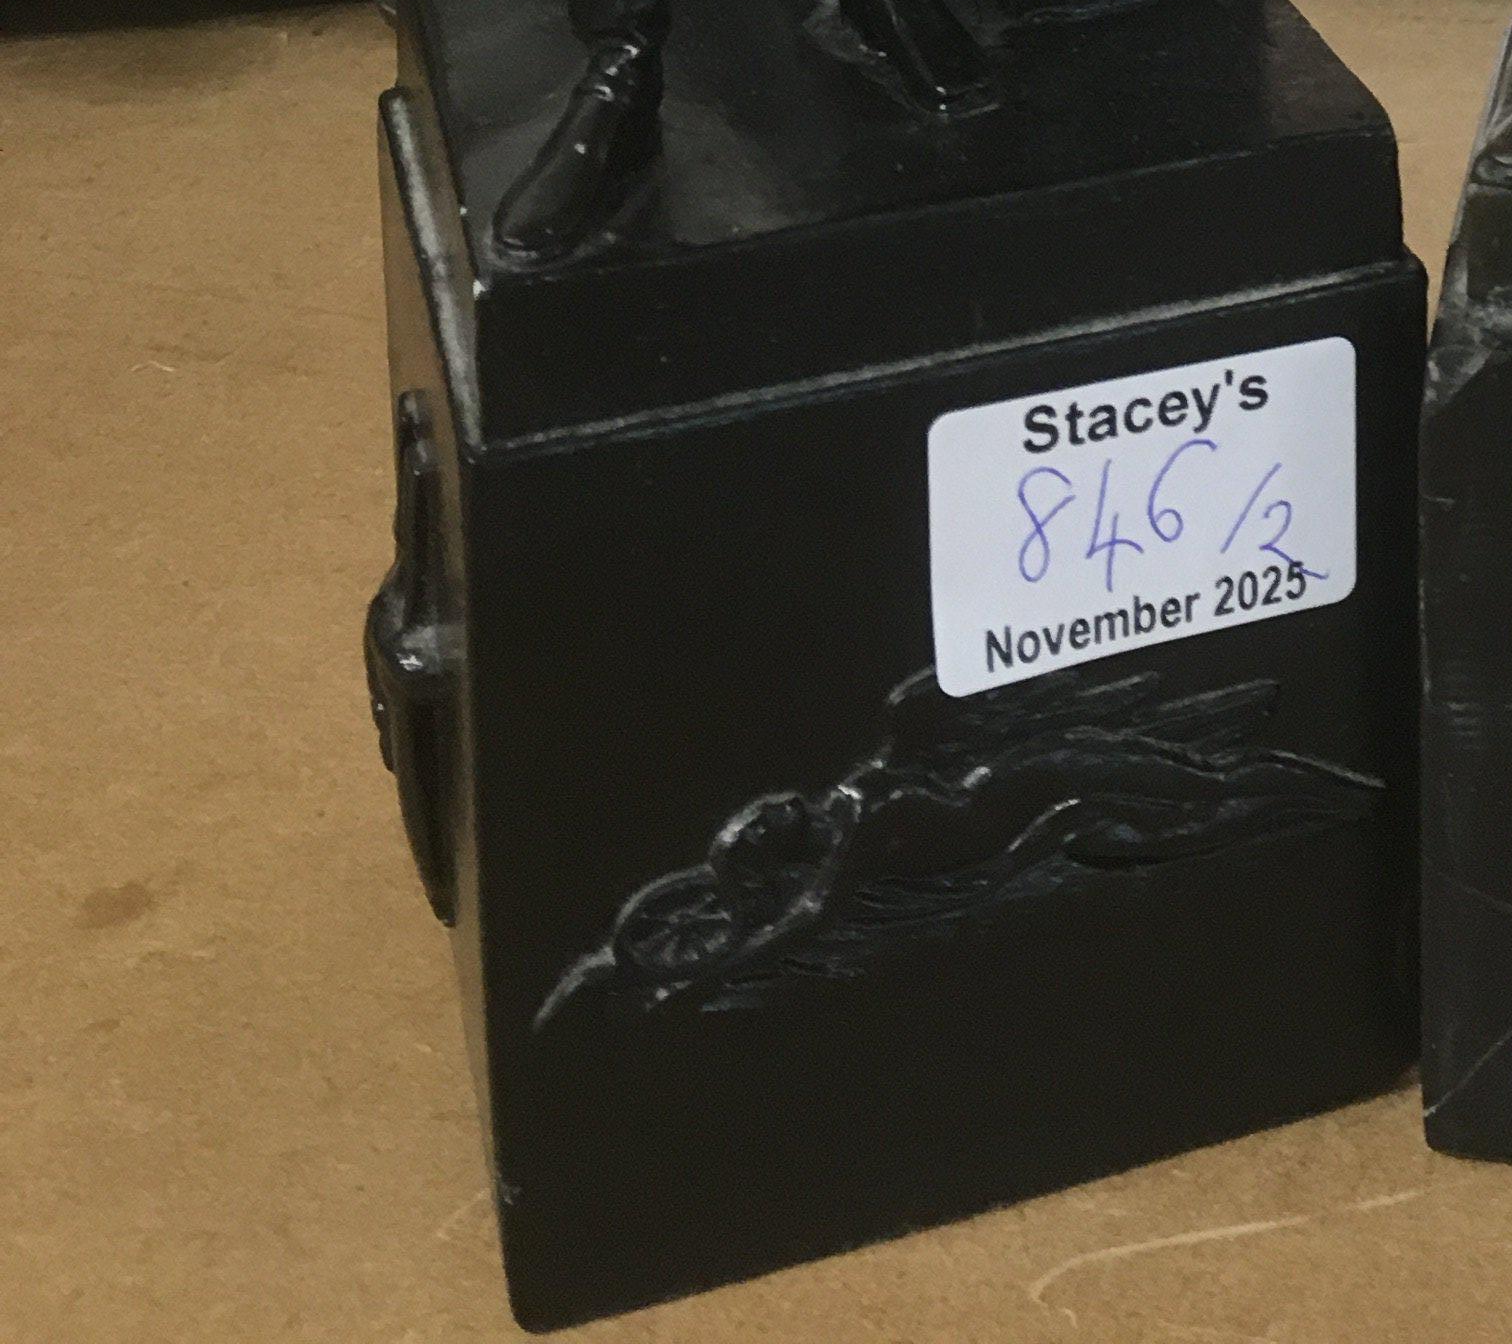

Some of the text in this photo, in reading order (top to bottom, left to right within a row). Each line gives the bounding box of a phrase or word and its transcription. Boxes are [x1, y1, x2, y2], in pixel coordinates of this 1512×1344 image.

[1023, 369, 1270, 454] Stacey's
[985, 561, 1307, 674] November 2025
